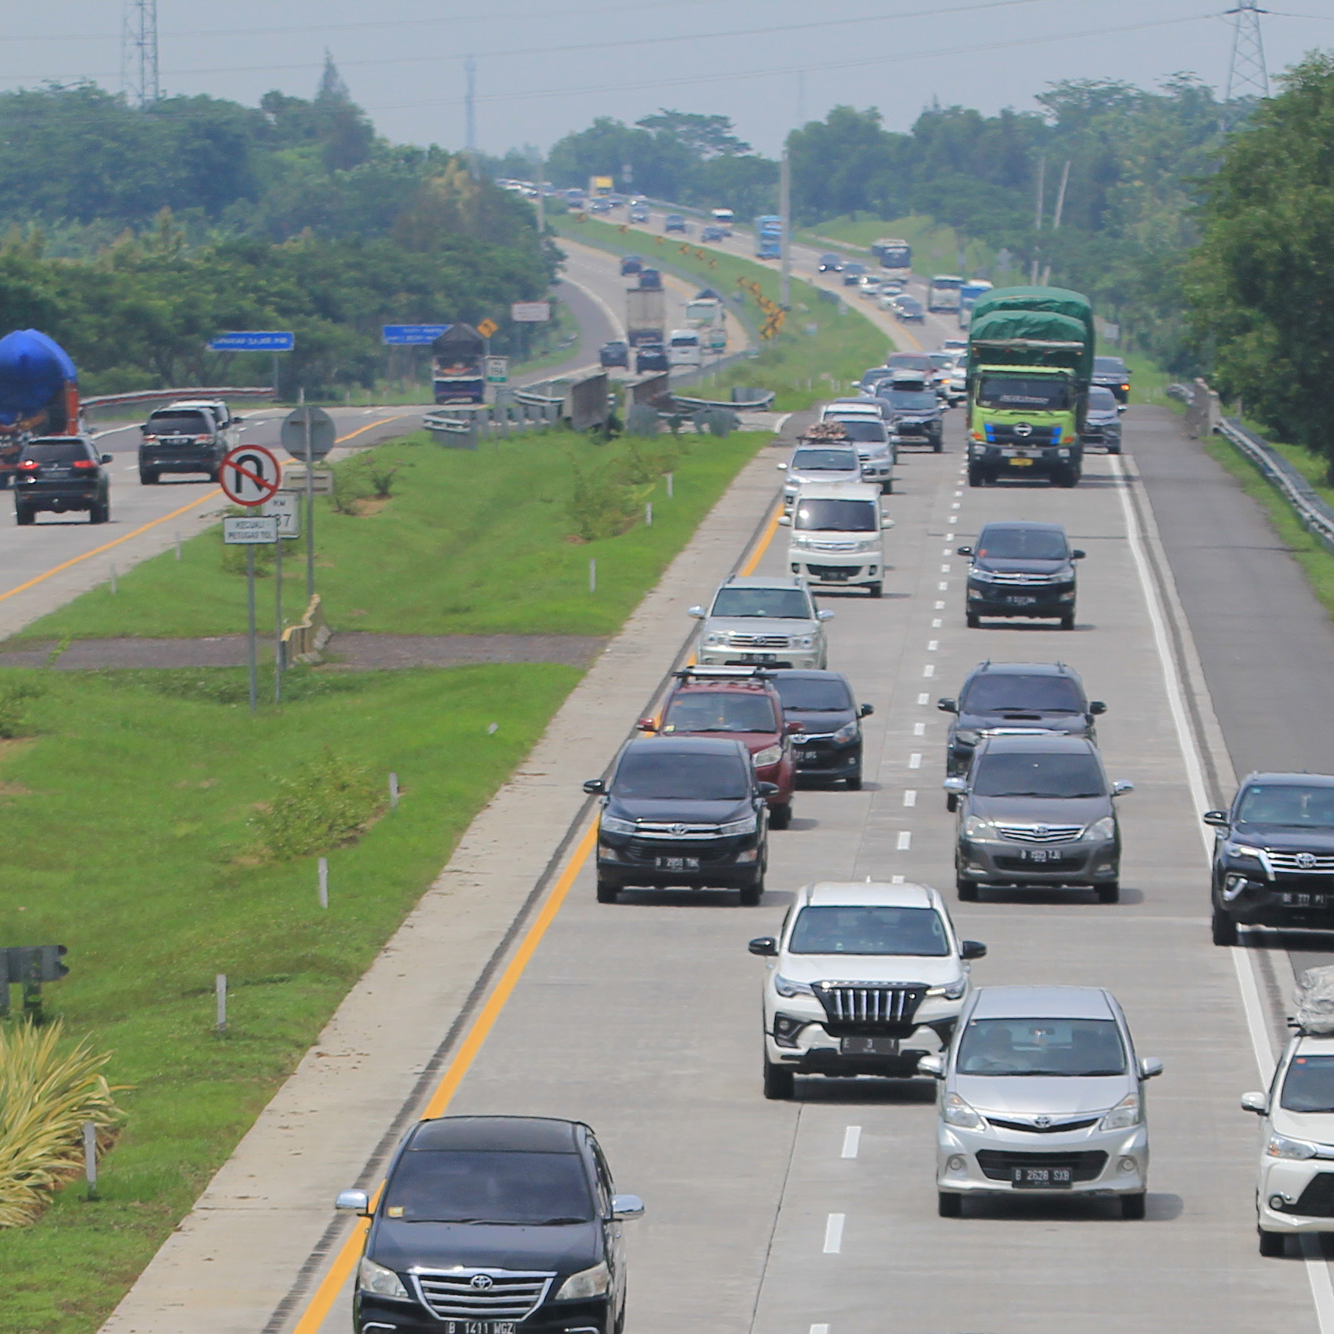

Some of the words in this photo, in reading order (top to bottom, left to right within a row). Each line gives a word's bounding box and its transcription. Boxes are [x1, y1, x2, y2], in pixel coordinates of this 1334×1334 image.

[1015, 1169, 1022, 1181] B
[448, 1322, 456, 1334] B
[465, 1322, 489, 1334] 1411
[493, 1322, 514, 1334] WGZ
